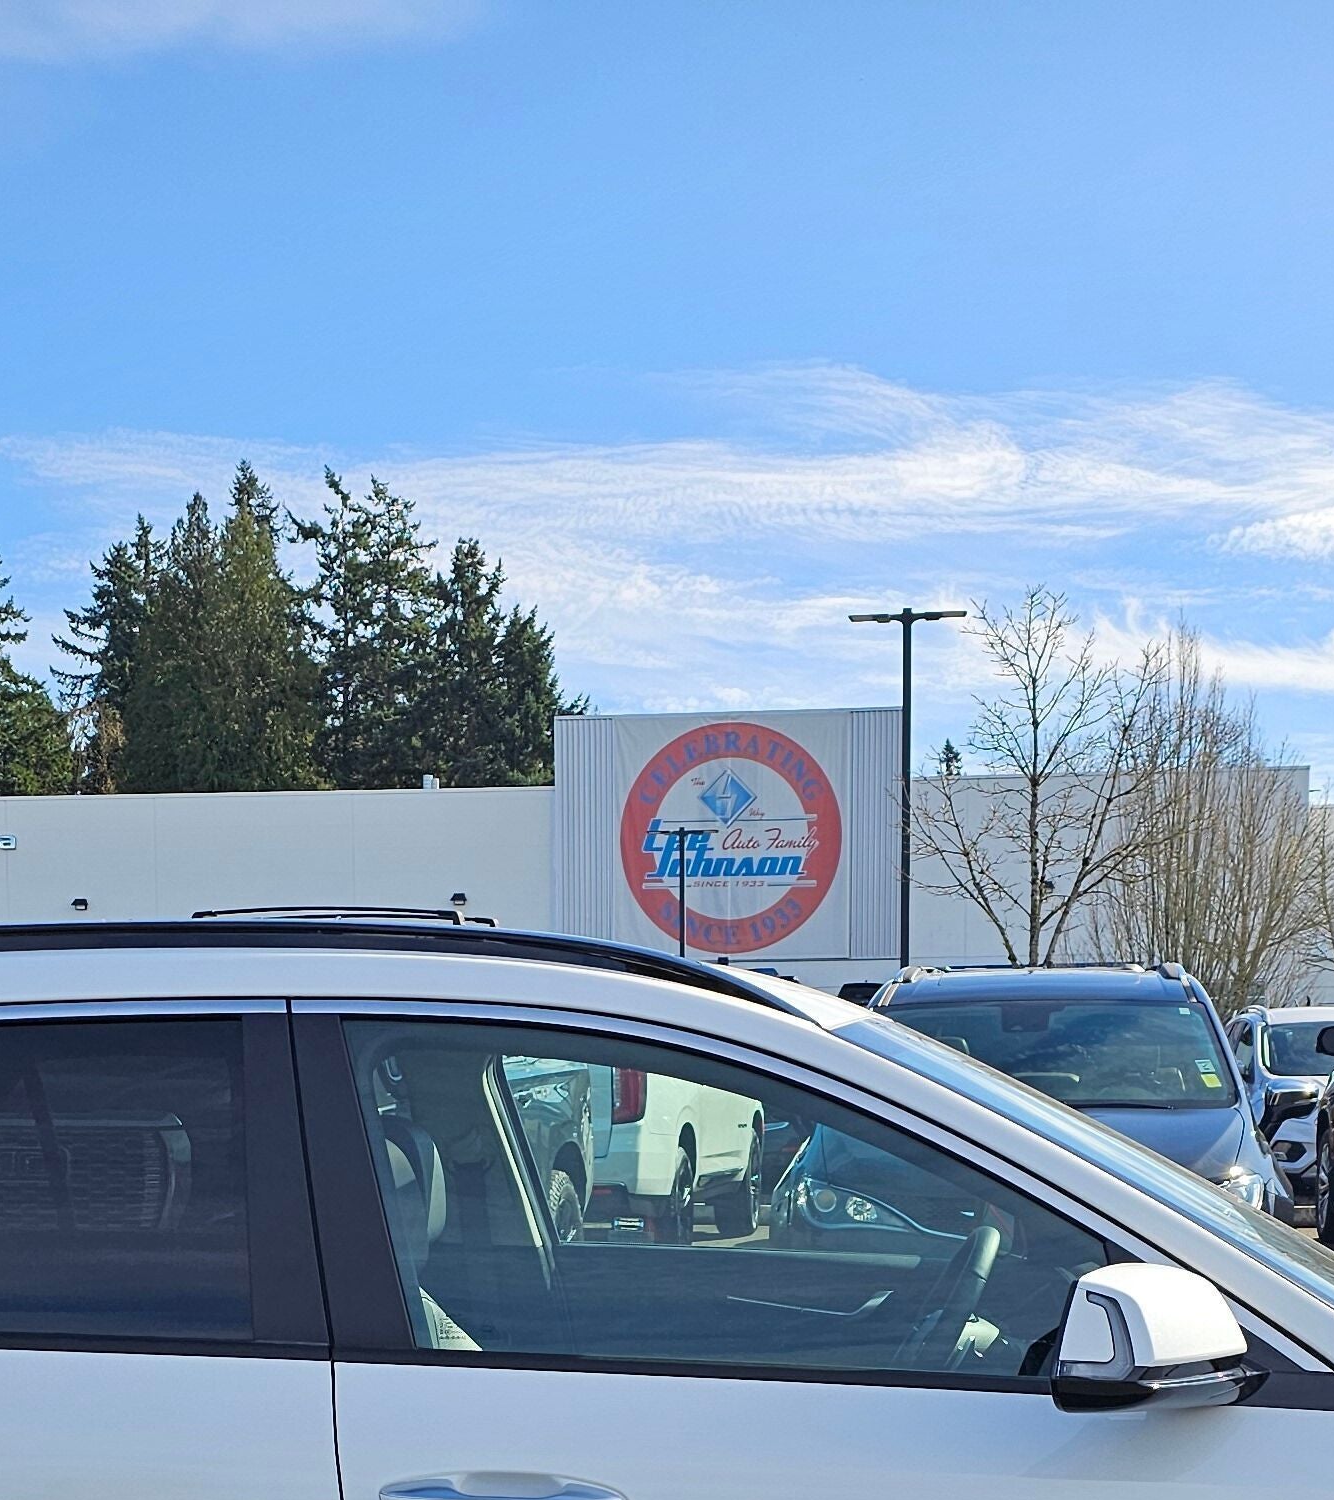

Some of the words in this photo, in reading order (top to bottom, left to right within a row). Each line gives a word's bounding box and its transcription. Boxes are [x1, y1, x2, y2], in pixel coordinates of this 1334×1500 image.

[639, 731, 824, 804] CELEBRATING
[643, 818, 714, 851] Lee
[722, 828, 760, 850] Auto
[765, 827, 819, 857] Family
[645, 845, 806, 878] Johnson
[693, 880, 730, 888] SINCE
[749, 897, 804, 943] 1933
